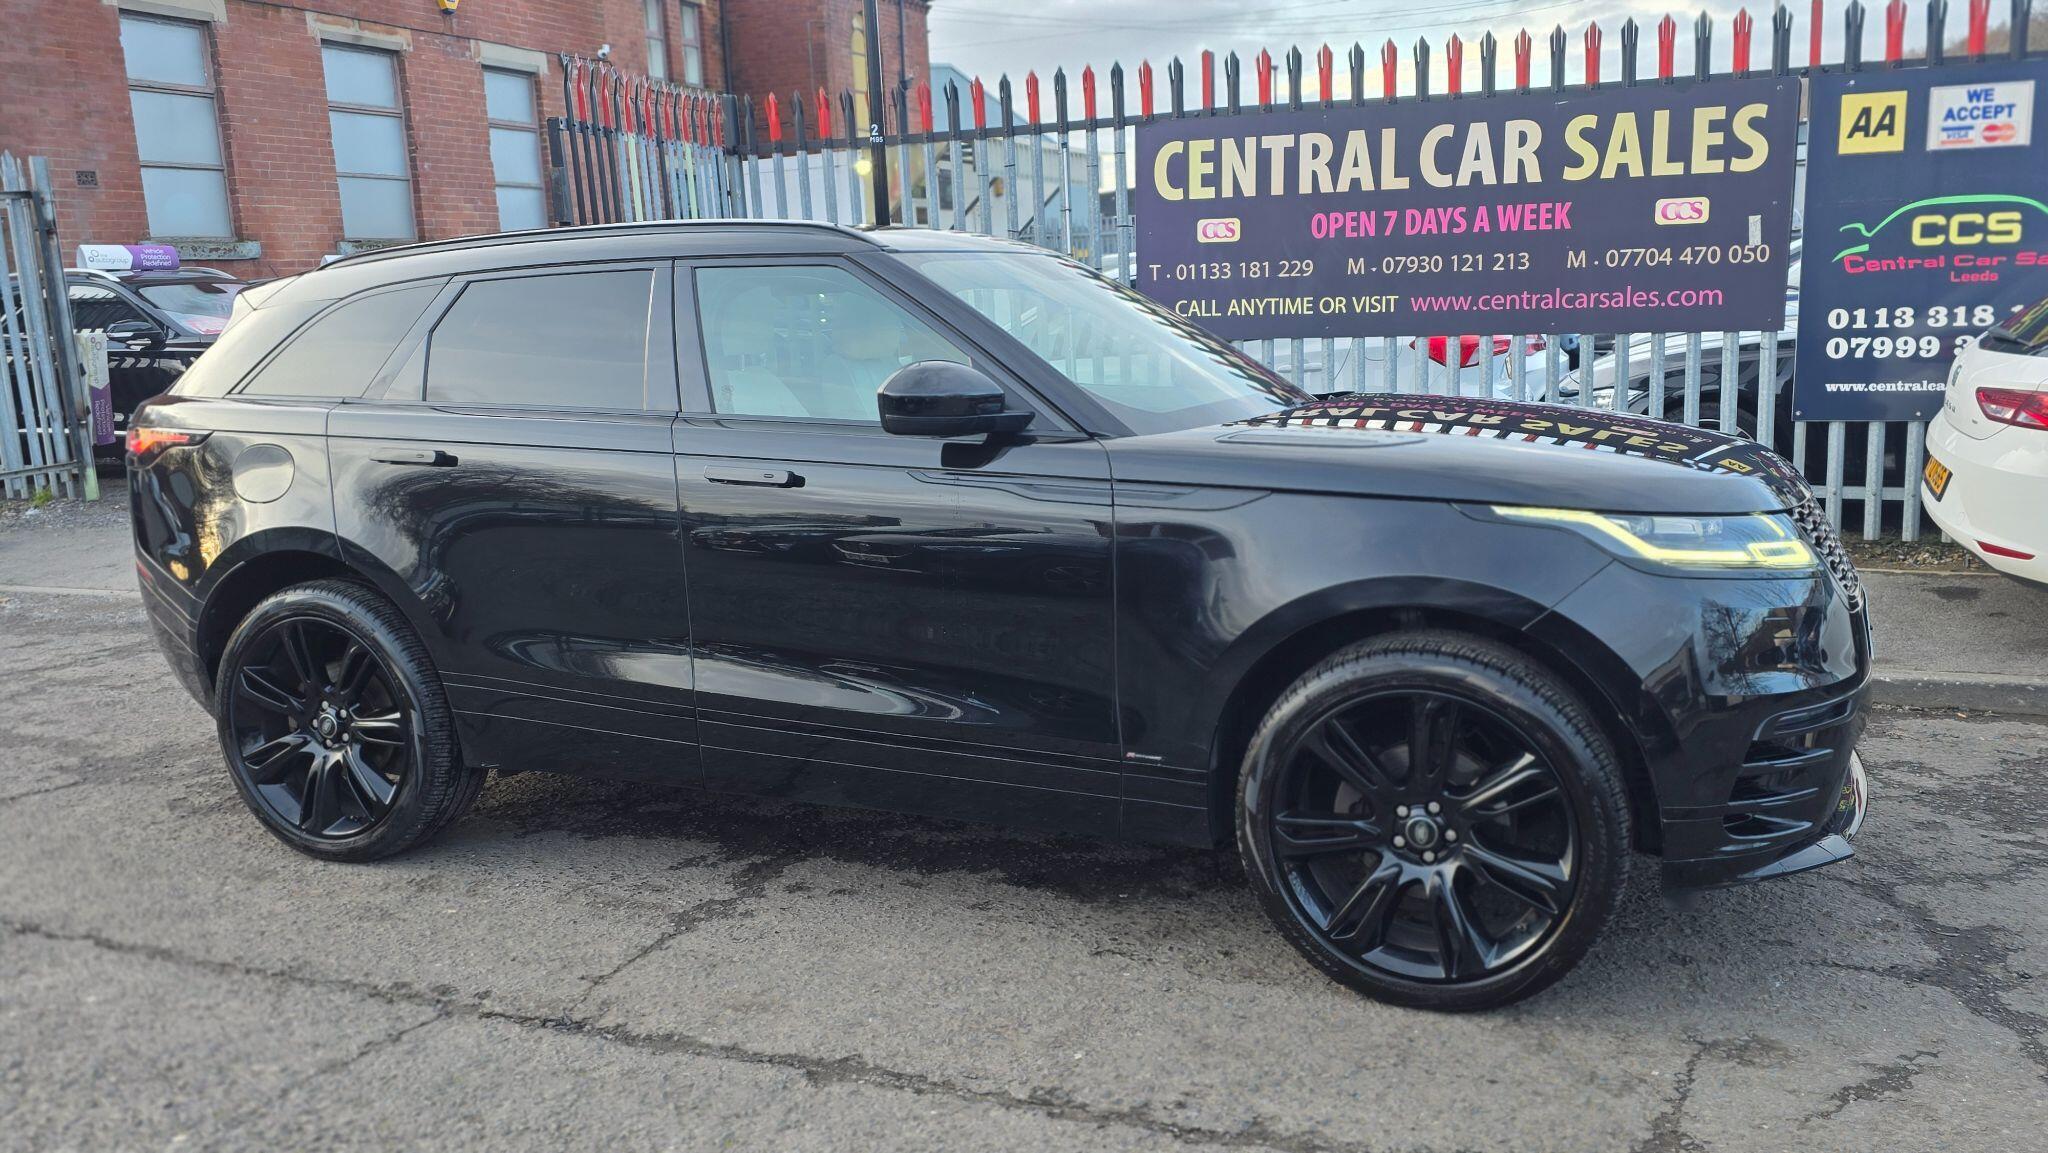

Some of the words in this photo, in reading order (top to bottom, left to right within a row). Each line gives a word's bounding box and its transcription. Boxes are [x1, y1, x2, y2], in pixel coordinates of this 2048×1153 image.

[1967, 88, 1995, 103] WE
[1846, 104, 1897, 139] AA
[1943, 103, 2017, 122] ACCEPT
[870, 123, 880, 136] 2
[1153, 127, 1411, 201] CENTRAL
[1419, 119, 1543, 189] CAR
[1562, 103, 1770, 182] SALES
[1311, 211, 1376, 240] OPEN
[1383, 210, 1398, 237] 7
[1405, 206, 1468, 237] DAYS
[1473, 205, 1491, 233] A
[1497, 201, 1573, 232] WEEK
[1661, 201, 1704, 221] CCS
[1201, 221, 1236, 240] CCS
[1911, 211, 2023, 247] CCS
[1176, 262, 1232, 281] 01133
[1239, 261, 1270, 279] 181
[1277, 259, 1314, 278] 229
[1382, 255, 1444, 275] 07930
[1451, 253, 1484, 273] 121
[1492, 252, 1530, 272] 213
[1606, 247, 1673, 268] 07704
[1679, 246, 1721, 265] 470
[1728, 244, 1770, 264] 050
[1843, 254, 1945, 274] Central
[1953, 253, 2007, 267] Car
[1951, 270, 1999, 282] Leeds
[1175, 299, 1222, 317] CALL
[1227, 296, 1314, 316] ANYTIME
[1319, 296, 1347, 314] OR
[1352, 294, 1400, 314] VISIT
[1410, 285, 1724, 313] www.centralcarsales.com
[1827, 306, 1915, 330] 0113
[1926, 304, 1996, 328] 318
[1825, 335, 1941, 360] 07999
